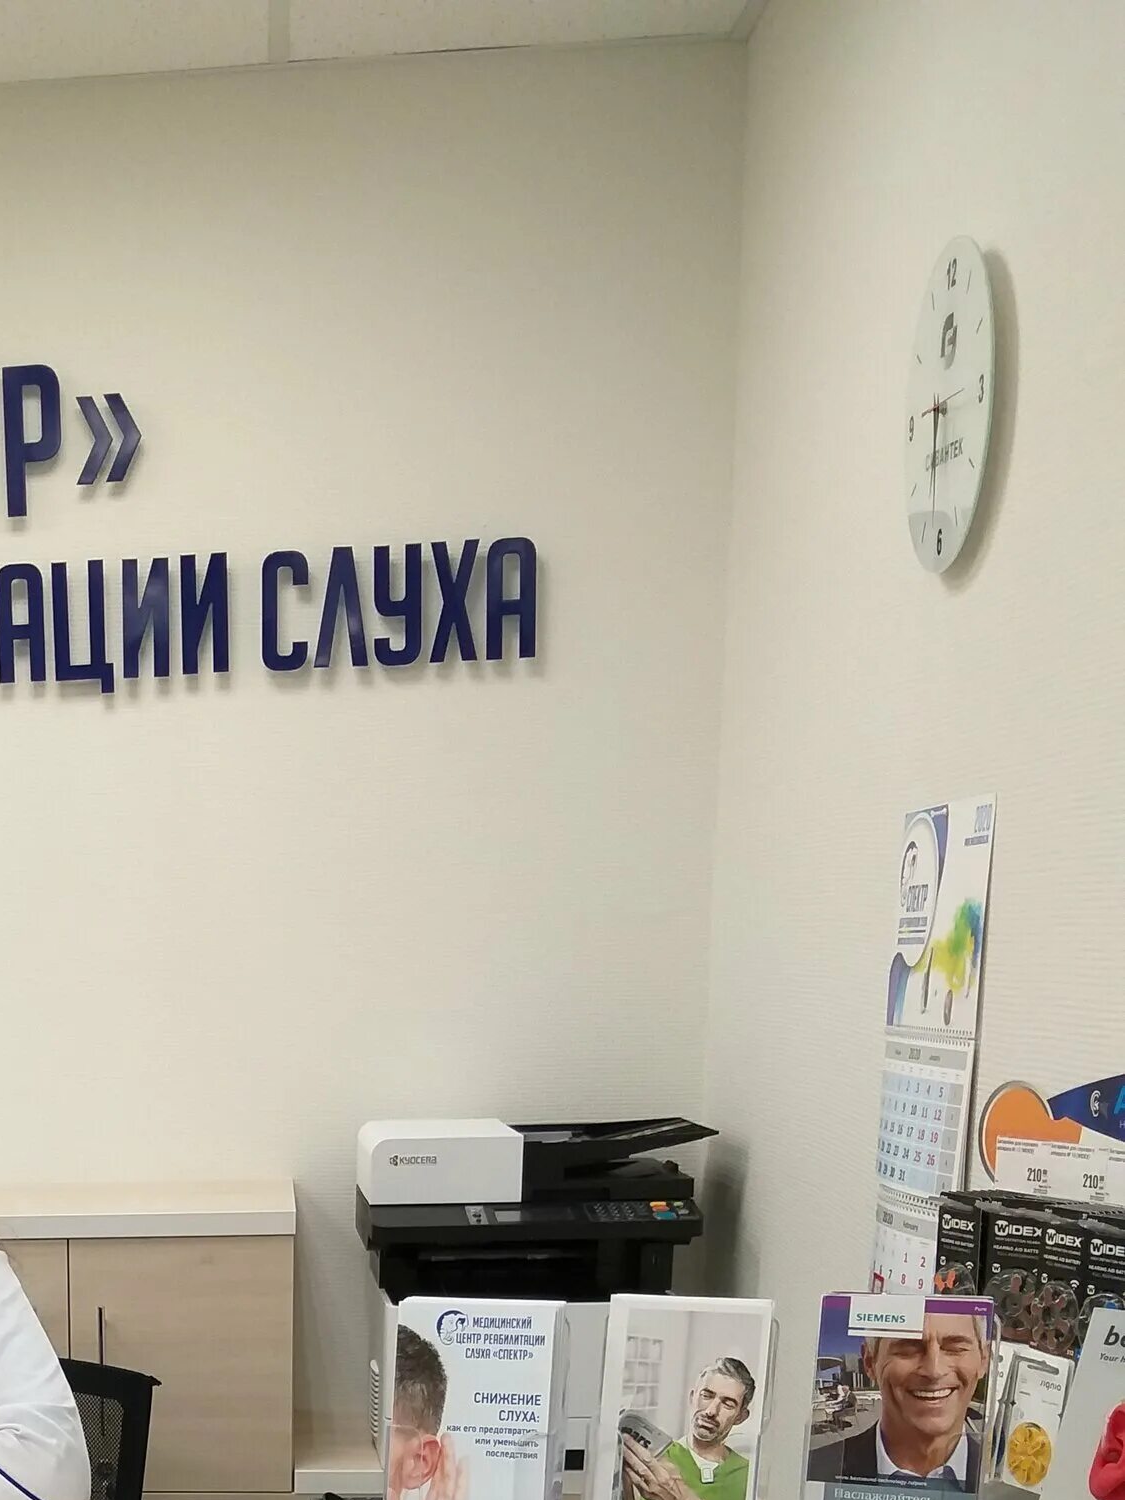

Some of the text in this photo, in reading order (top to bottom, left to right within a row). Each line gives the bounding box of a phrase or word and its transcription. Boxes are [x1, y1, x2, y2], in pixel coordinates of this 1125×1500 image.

[946, 258, 958, 290] 12
[978, 374, 985, 404] 3
[908, 416, 915, 443] 9
[936, 528, 943, 557] 6
[260, 538, 539, 672] СЛУХА
[399, 1155, 437, 1165] KYOCERA
[1027, 1168, 1042, 1182] 210
[1083, 1173, 1098, 1189] 210
[941, 1213, 975, 1232] WIDEX
[994, 1219, 1043, 1237] WIDEX
[1045, 1228, 1082, 1248] WIDEX
[472, 1316, 532, 1330] МЕДИЦИНСКИЙ
[856, 1313, 906, 1324] SIEMENS
[455, 1333, 546, 1347] ЦЕНТР РЕАБИЛИТАЦИИ
[465, 1348, 491, 1360] СЛУХА
[1100, 1352, 1119, 1362] Your
[474, 1392, 542, 1406] СНИЖЕНИЕ
[499, 1410, 540, 1423] СЛУХА:
[493, 1439, 539, 1448] уменьшить
[486, 1450, 538, 1460] последствия
